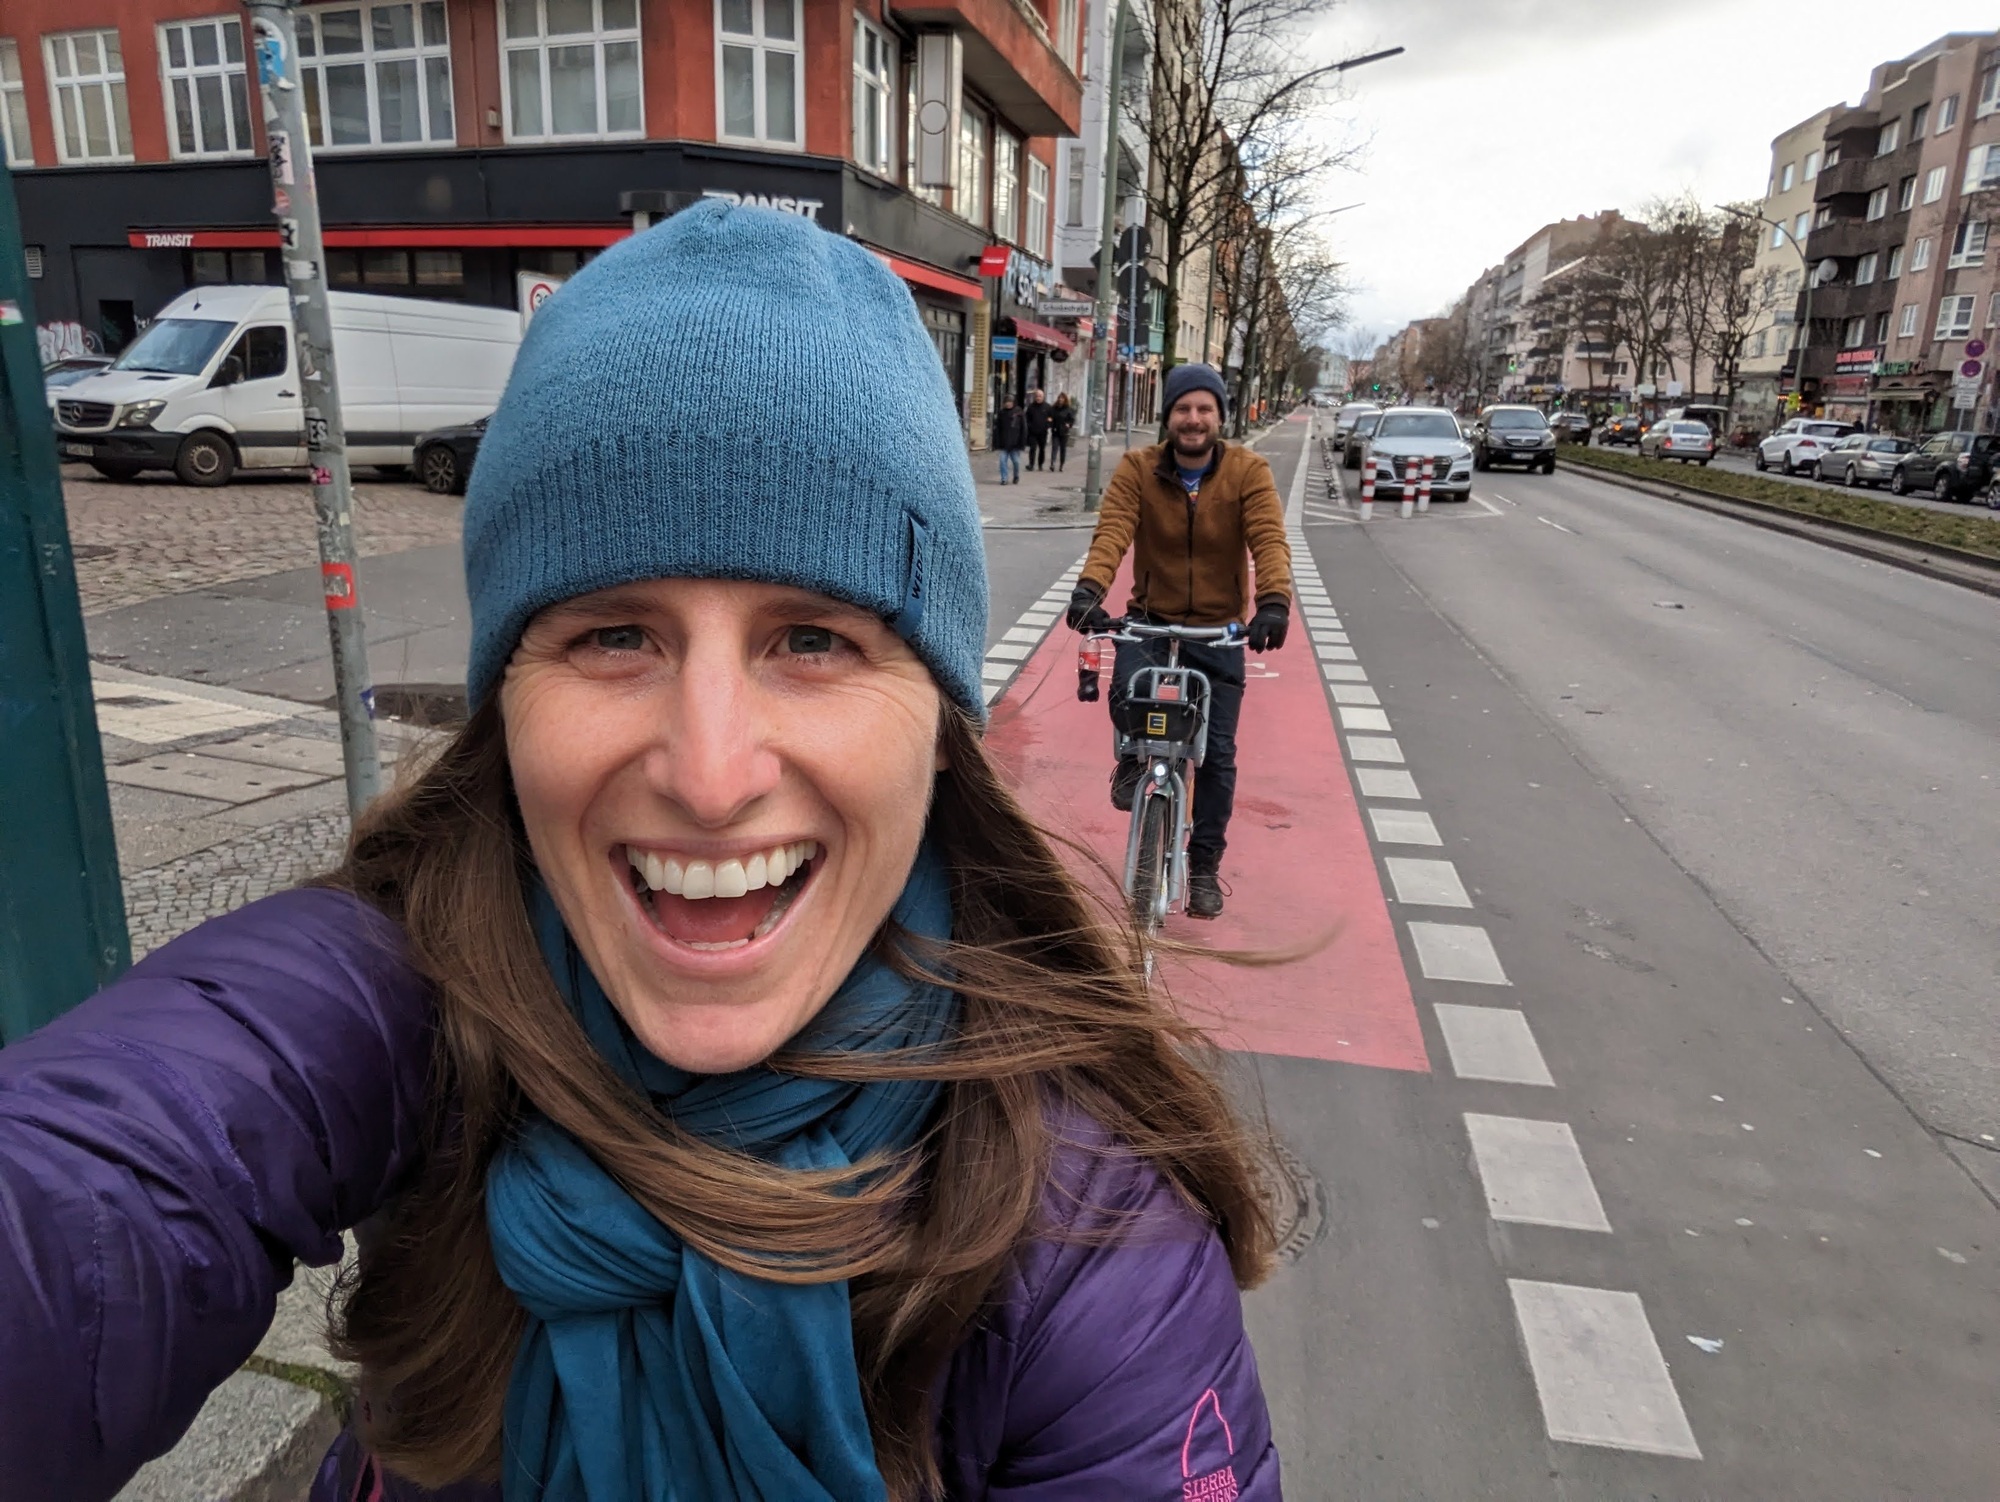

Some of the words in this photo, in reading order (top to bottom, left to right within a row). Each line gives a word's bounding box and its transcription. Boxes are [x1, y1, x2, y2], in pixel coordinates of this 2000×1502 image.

[145, 233, 194, 248] TRANSIT
[1182, 1465, 1237, 1500] SIERRA
[1185, 1483, 1239, 1502] SIGNS
